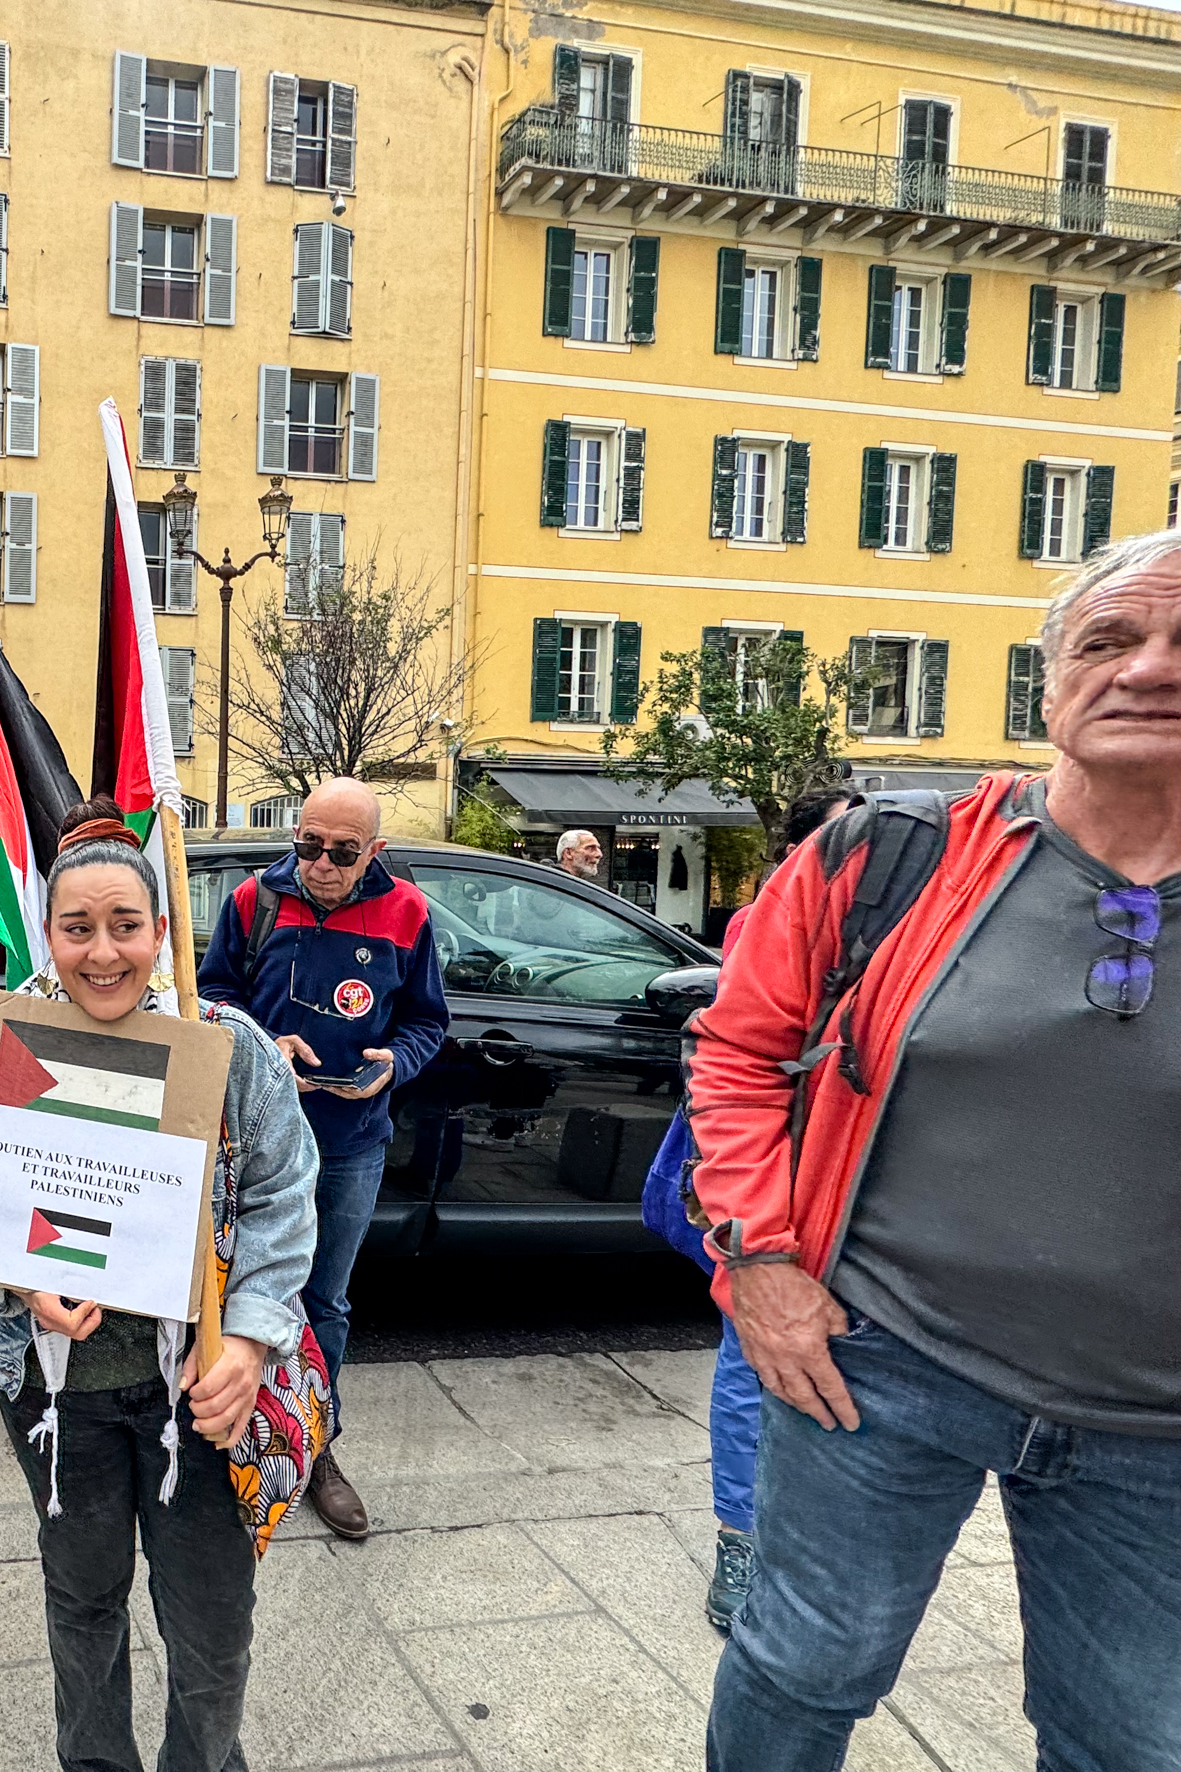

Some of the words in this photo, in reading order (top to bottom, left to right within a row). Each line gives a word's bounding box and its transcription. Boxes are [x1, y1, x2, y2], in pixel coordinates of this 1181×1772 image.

[621, 814, 687, 824] SPONTINI
[343, 986, 364, 999] cgt
[22, 1162, 40, 1175] ET
[42, 1165, 141, 1195] TRAVAILLEURS
[45, 1151, 73, 1166] AUX
[75, 1156, 183, 1187] TRAVAILLEUSES
[30, 1179, 124, 1208] PALESTINIENS
